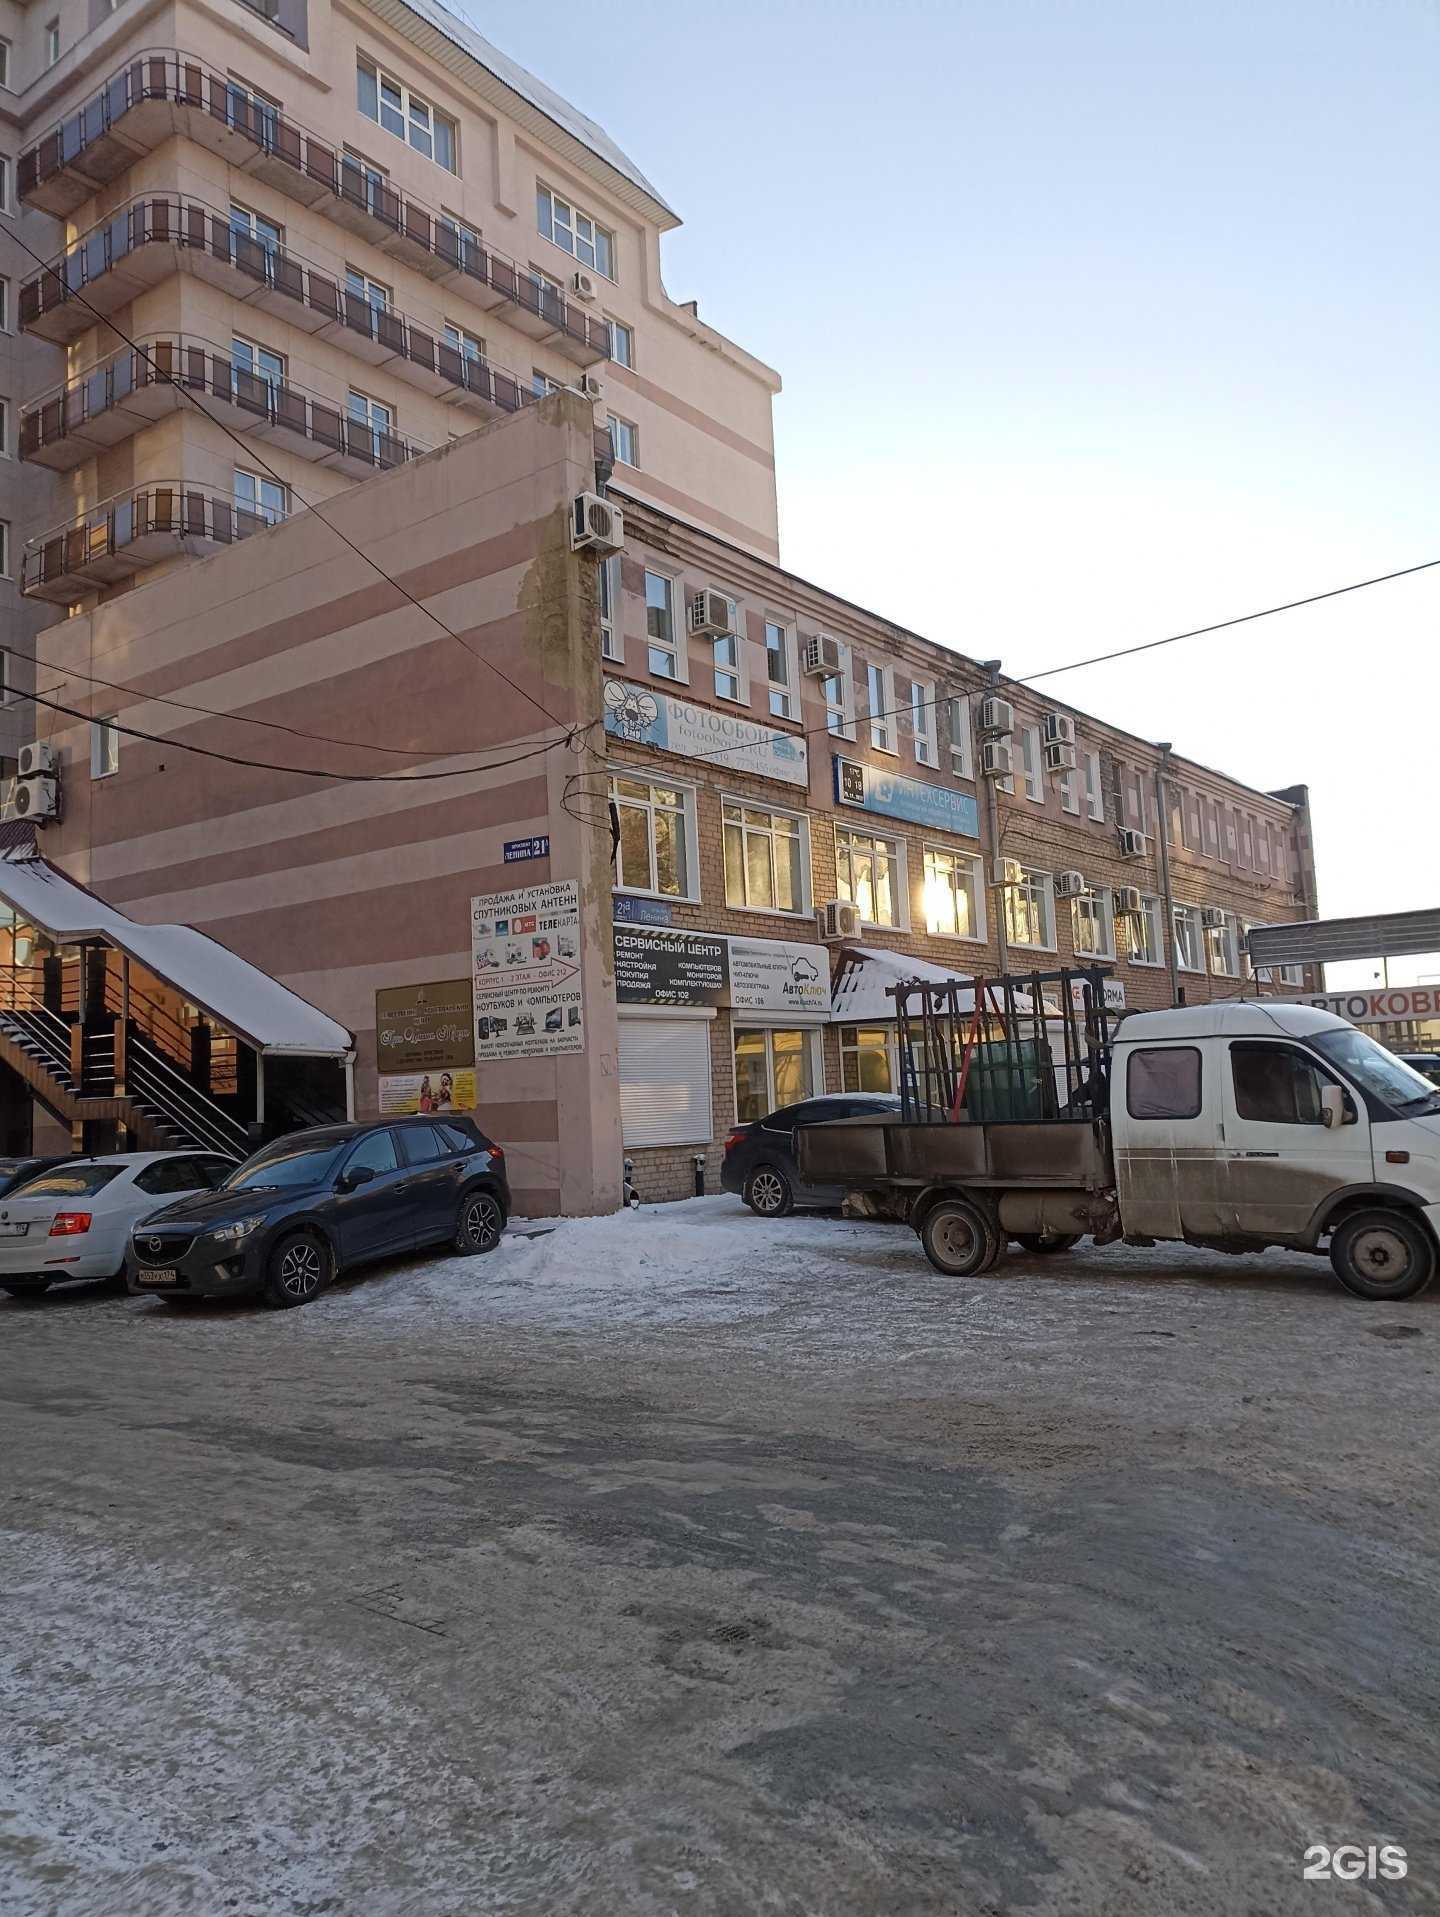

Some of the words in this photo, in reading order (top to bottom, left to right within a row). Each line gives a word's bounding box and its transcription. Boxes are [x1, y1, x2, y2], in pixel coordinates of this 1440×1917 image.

[479, 894, 515, 907] ПРОДАЖА
[518, 892, 524, 900] И
[528, 883, 571, 898] УСТАНОВКА
[473, 901, 537, 920] СПУТНИКОВЫХ
[540, 895, 577, 909] АНТЕНН
[539, 917, 578, 930] ТЕЛЕКАРТА
[615, 935, 685, 953] СЕРВИСНЫЙ
[688, 943, 721, 956] ЦЕНТР
[616, 950, 644, 959] РЕМОНТ
[616, 960, 657, 970] НАСТРОЙКА
[678, 962, 722, 972] КОМПЬЮТЕРОВ
[616, 970, 649, 979] ПОКУПКА
[687, 971, 722, 981] МОНИТОРОВ
[617, 980, 651, 989] ПРОДАЖА
[669, 979, 722, 989] КОМПЛЕКТУЮЩИХ
[655, 989, 676, 998] ОФИС
[678, 991, 689, 999] 102
[736, 996, 753, 1004] ОФИС
[476, 999, 514, 1011] НОУТБУКОВ
[527, 992, 581, 1006] КОМПЬЮТЕРОВ
[1296, 990, 1440, 1018] ВТОКОВ
